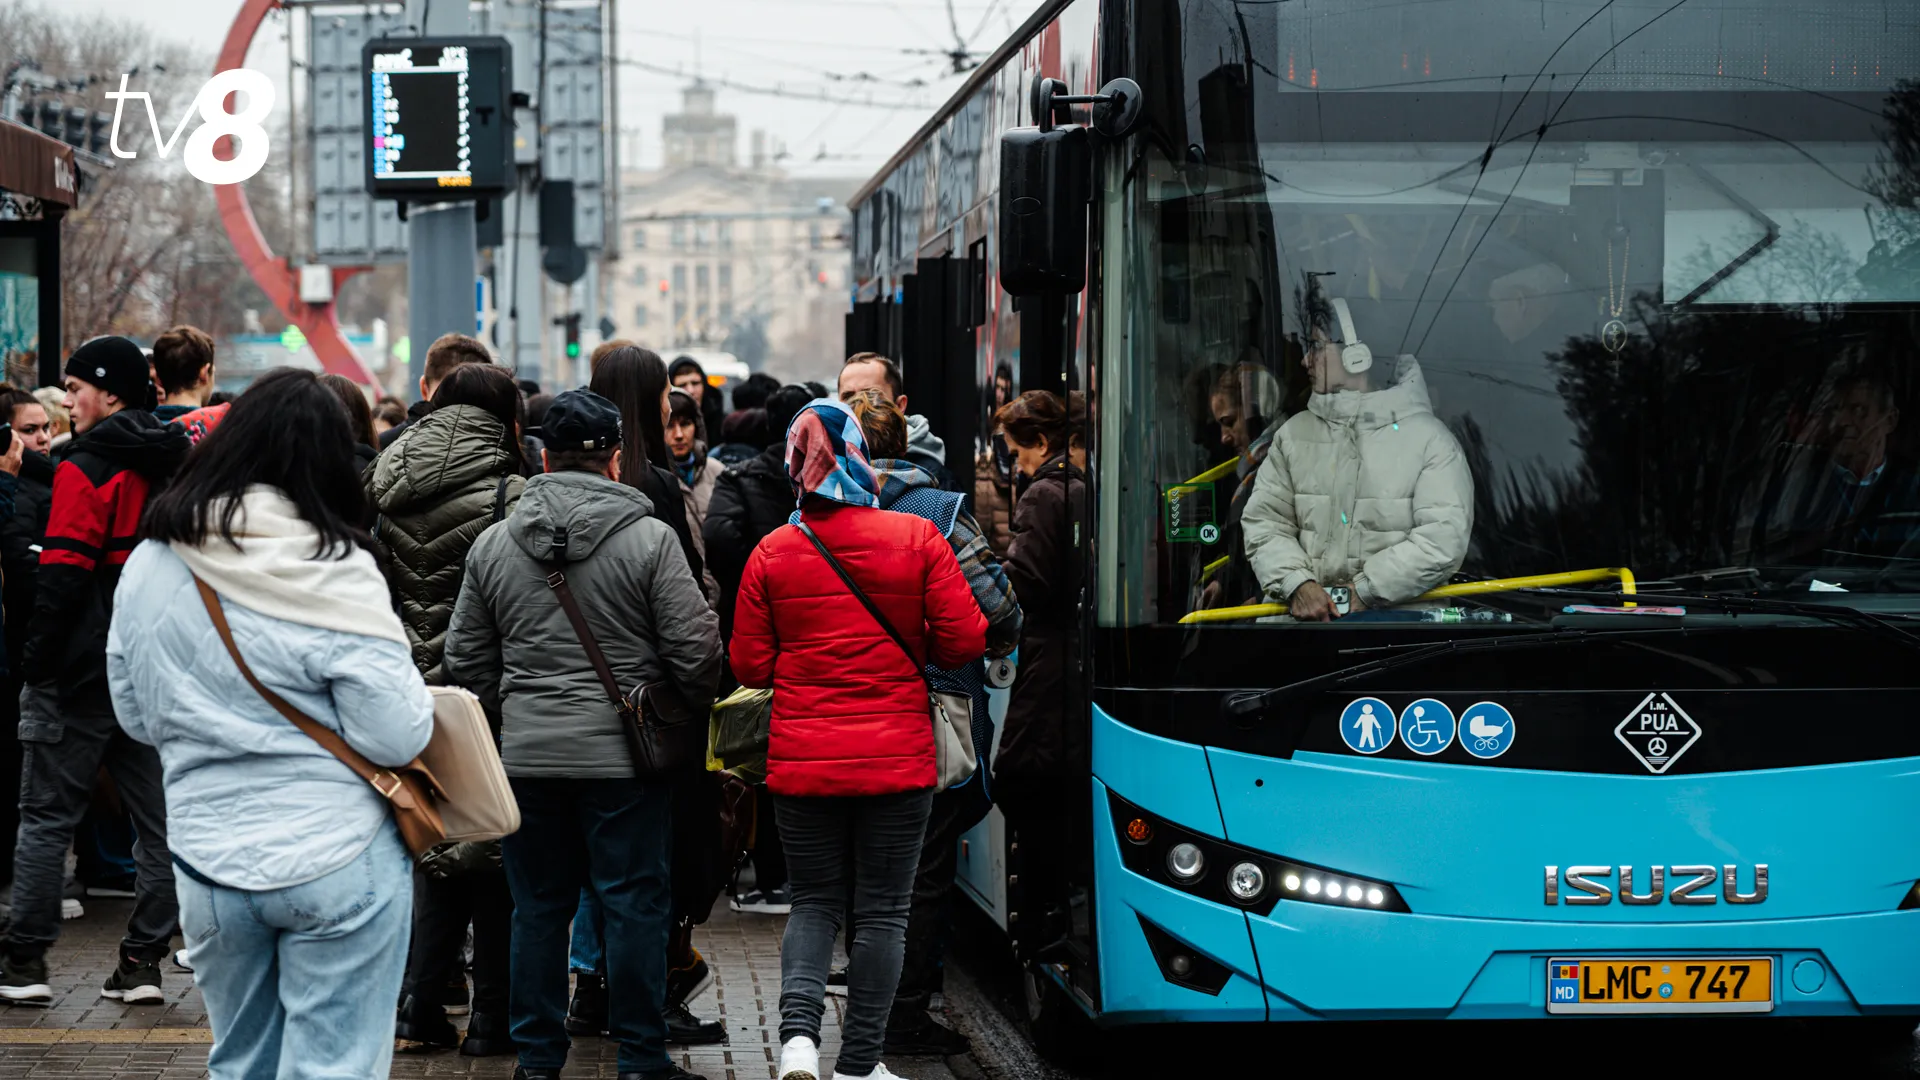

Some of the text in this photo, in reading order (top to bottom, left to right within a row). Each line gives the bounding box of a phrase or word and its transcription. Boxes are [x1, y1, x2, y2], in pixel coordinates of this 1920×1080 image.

[1203, 528, 1215, 539] OK
[1640, 713, 1679, 731] PUA
[1544, 864, 1769, 906] ISUZU
[1583, 965, 1751, 1000] LMC 747
[1555, 986, 1575, 1000] MD
